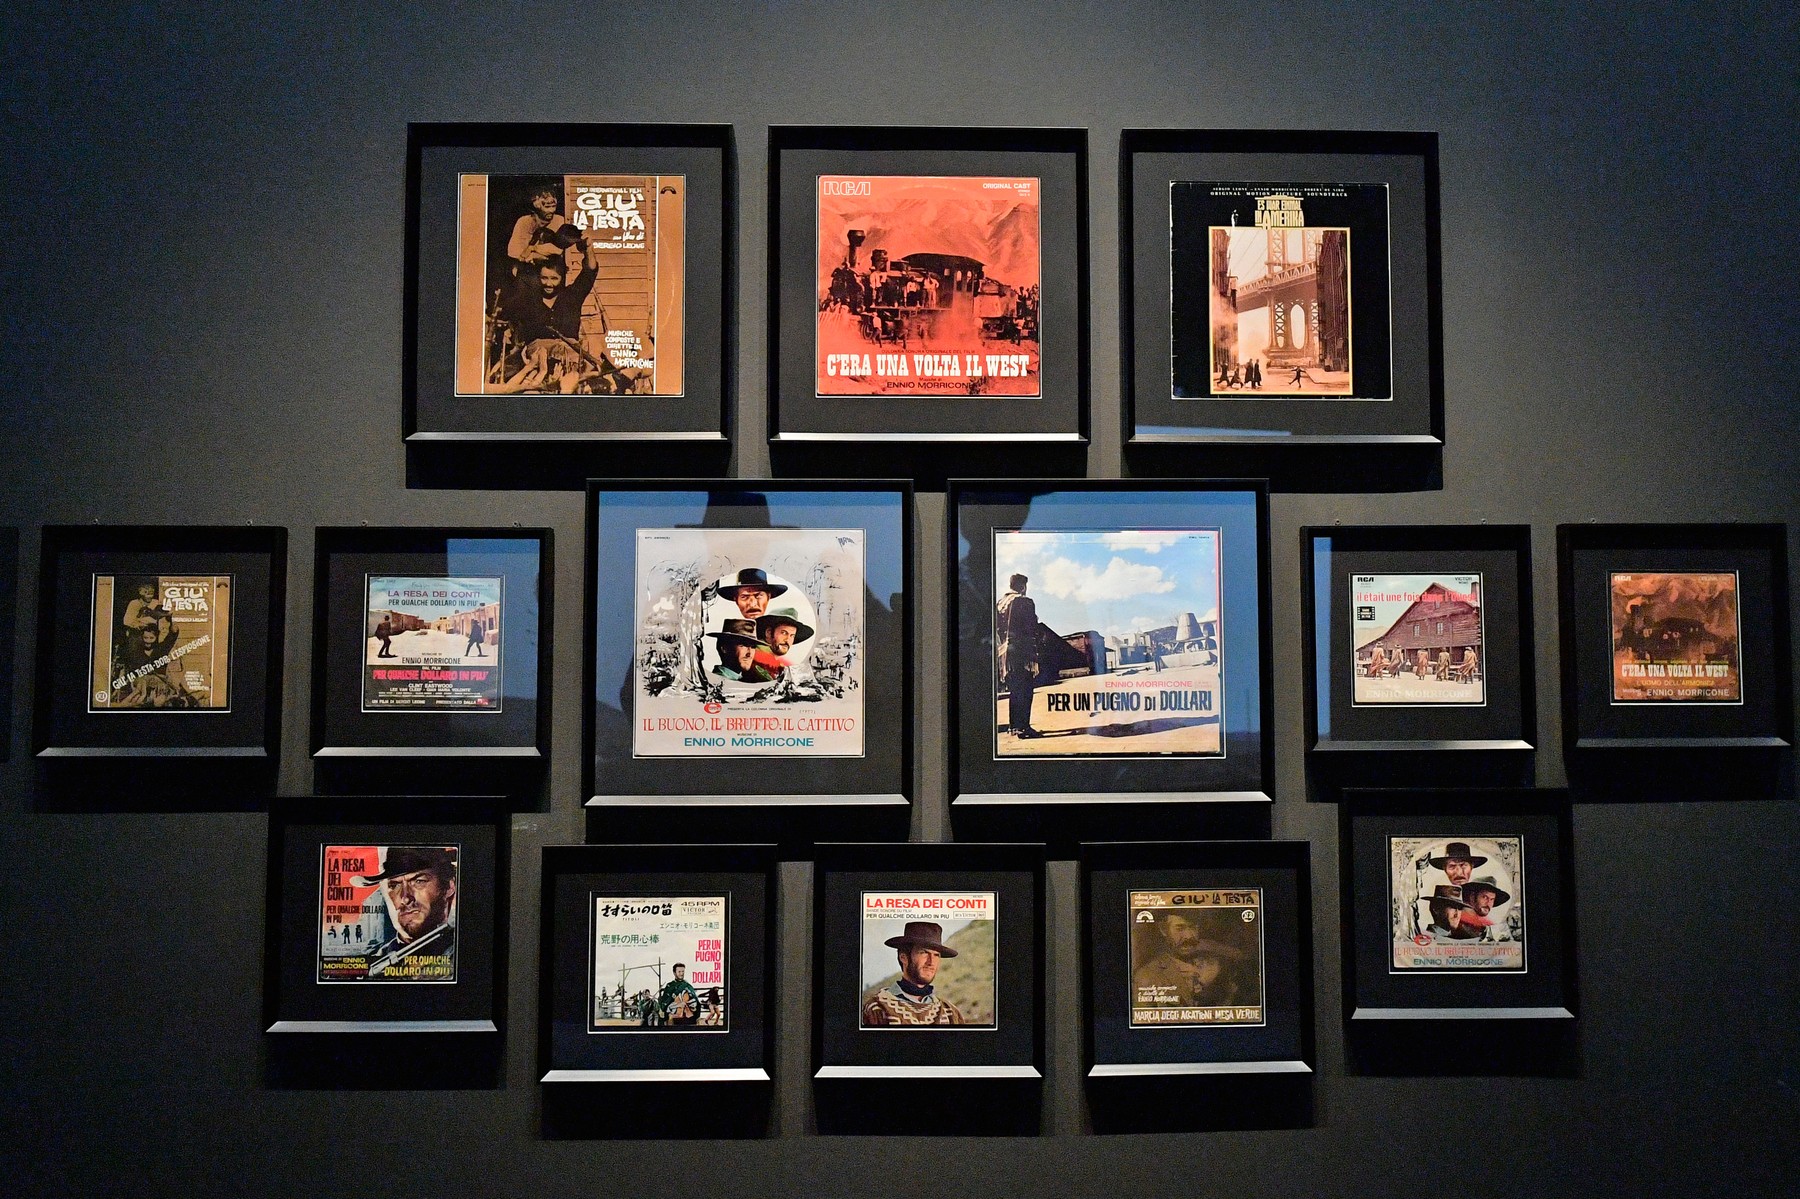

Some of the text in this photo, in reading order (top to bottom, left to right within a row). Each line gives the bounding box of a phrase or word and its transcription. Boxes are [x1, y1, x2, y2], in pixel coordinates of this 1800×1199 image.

[824, 181, 870, 195] RCA
[1257, 200, 1265, 210] ES
[572, 209, 645, 231] LA TESTA
[1262, 210, 1305, 230] AMERIKA
[614, 358, 654, 368] MORRICONE
[827, 354, 1029, 377] C'ERA UNA VOLTA IL WEST
[433, 590, 447, 598] DEI
[1357, 592, 1362, 601] il
[1386, 593, 1401, 601] une
[1404, 592, 1420, 602] fois
[162, 597, 209, 611] LA TESTA
[421, 670, 458, 680] DOLLARO
[460, 671, 470, 680] IN
[1621, 665, 1729, 677] C'ERA UNA VOLTA IL WEST
[1047, 693, 1071, 712] PER
[1074, 693, 1090, 711] UN
[1094, 691, 1141, 711] PUGNO
[1160, 690, 1212, 711] DOLLARI
[643, 718, 654, 731] IL
[711, 718, 722, 731] IL
[784, 718, 794, 731] IL
[797, 718, 855, 731] CATTIVO
[684, 738, 814, 747] ENNIO MORRICONE
[328, 858, 365, 872] LA RESA
[328, 873, 341, 886] DEI
[328, 886, 353, 900] CONTI
[1212, 893, 1220, 904] LA
[1222, 893, 1254, 904] TESTA
[866, 898, 987, 909] LA RESA DEI CONTI
[326, 905, 336, 913] PER
[338, 905, 360, 914] QUALCHE
[601, 902, 672, 917] さすらいの口笛
[601, 934, 660, 945] 荒野の用心棒
[698, 940, 721, 950] PER UN
[404, 956, 451, 966] PER QUALCHE
[695, 951, 721, 962] PUGNO
[384, 967, 421, 976] DOLLARO
[423, 967, 433, 976] IN
[714, 962, 721, 971] DI
[692, 971, 721, 983] DOLLARI
[1215, 1010, 1234, 1021] MESA
[1236, 1008, 1260, 1020] VERDE
